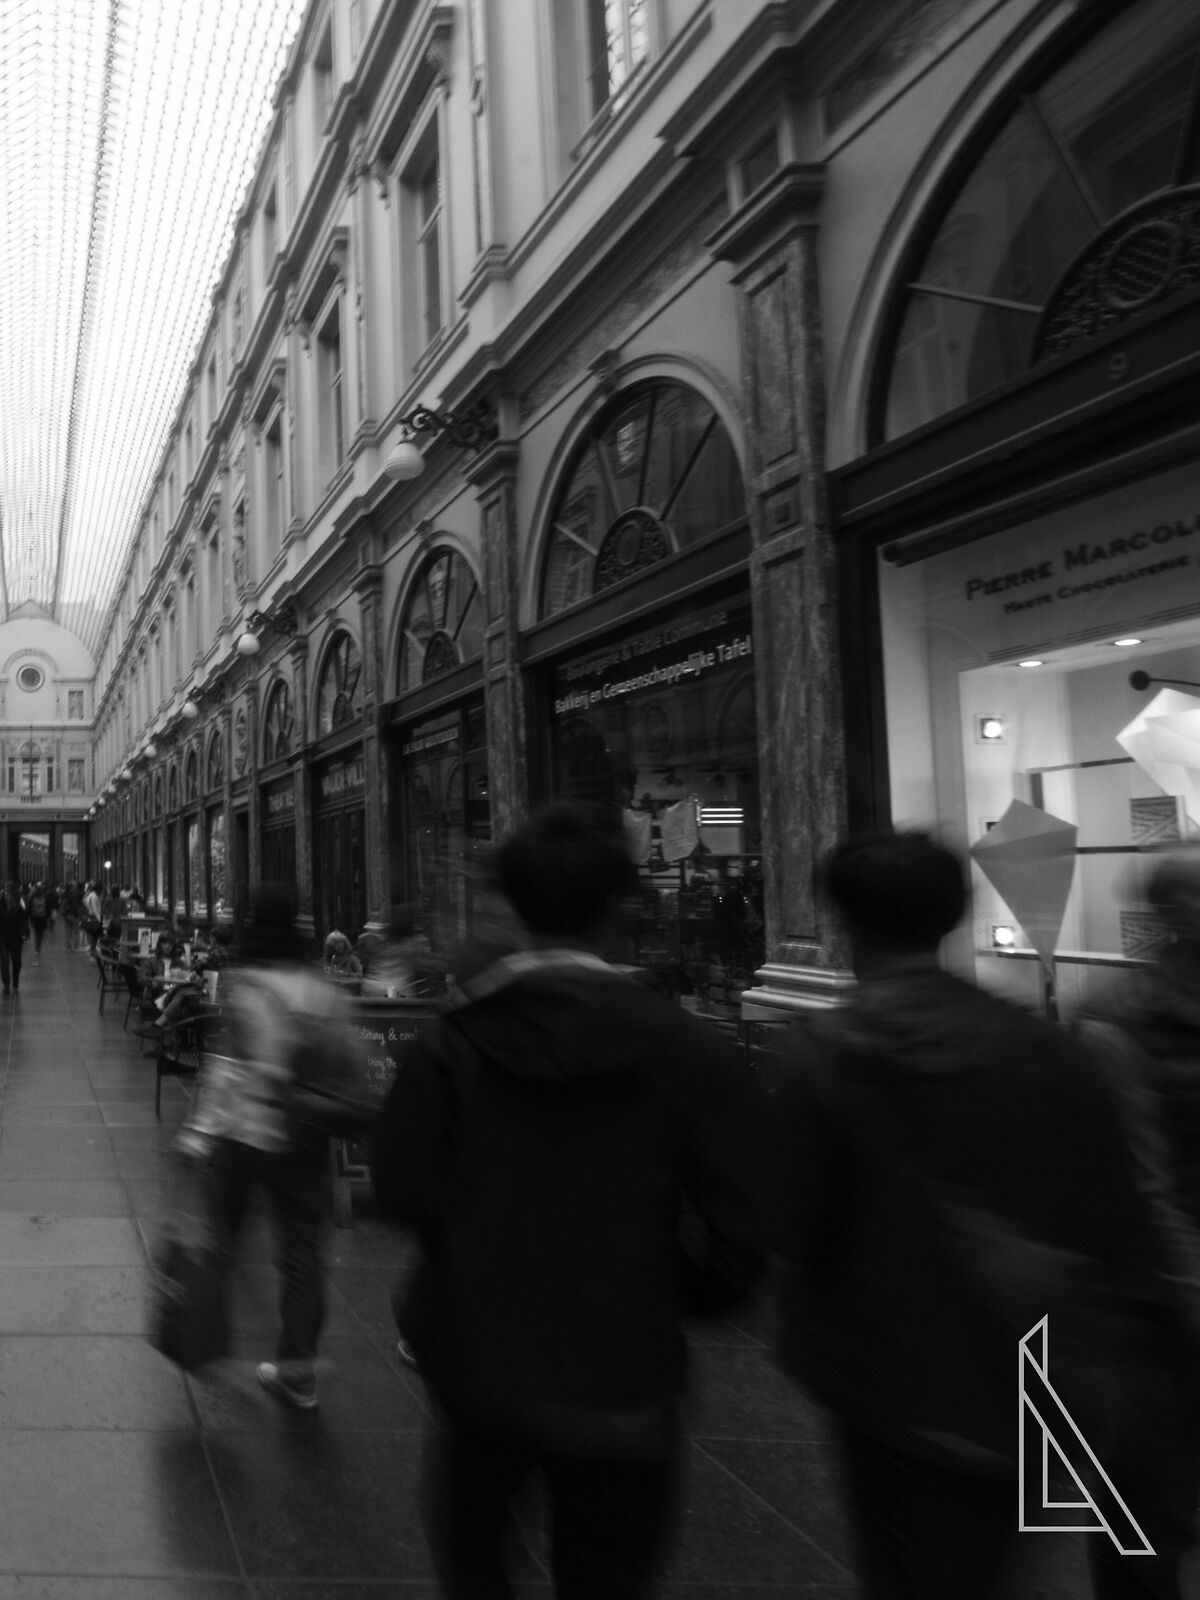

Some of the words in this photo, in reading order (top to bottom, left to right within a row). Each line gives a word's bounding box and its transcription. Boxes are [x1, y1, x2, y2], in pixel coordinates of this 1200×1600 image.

[965, 561, 1053, 601] PIERRE
[1057, 555, 1189, 599] CHOCOLATERIE
[555, 690, 590, 714] Bakkerij
[590, 690, 602, 704] en
[602, 650, 716, 699] Gemeenschappelijke
[716, 634, 752, 663] Tafel
